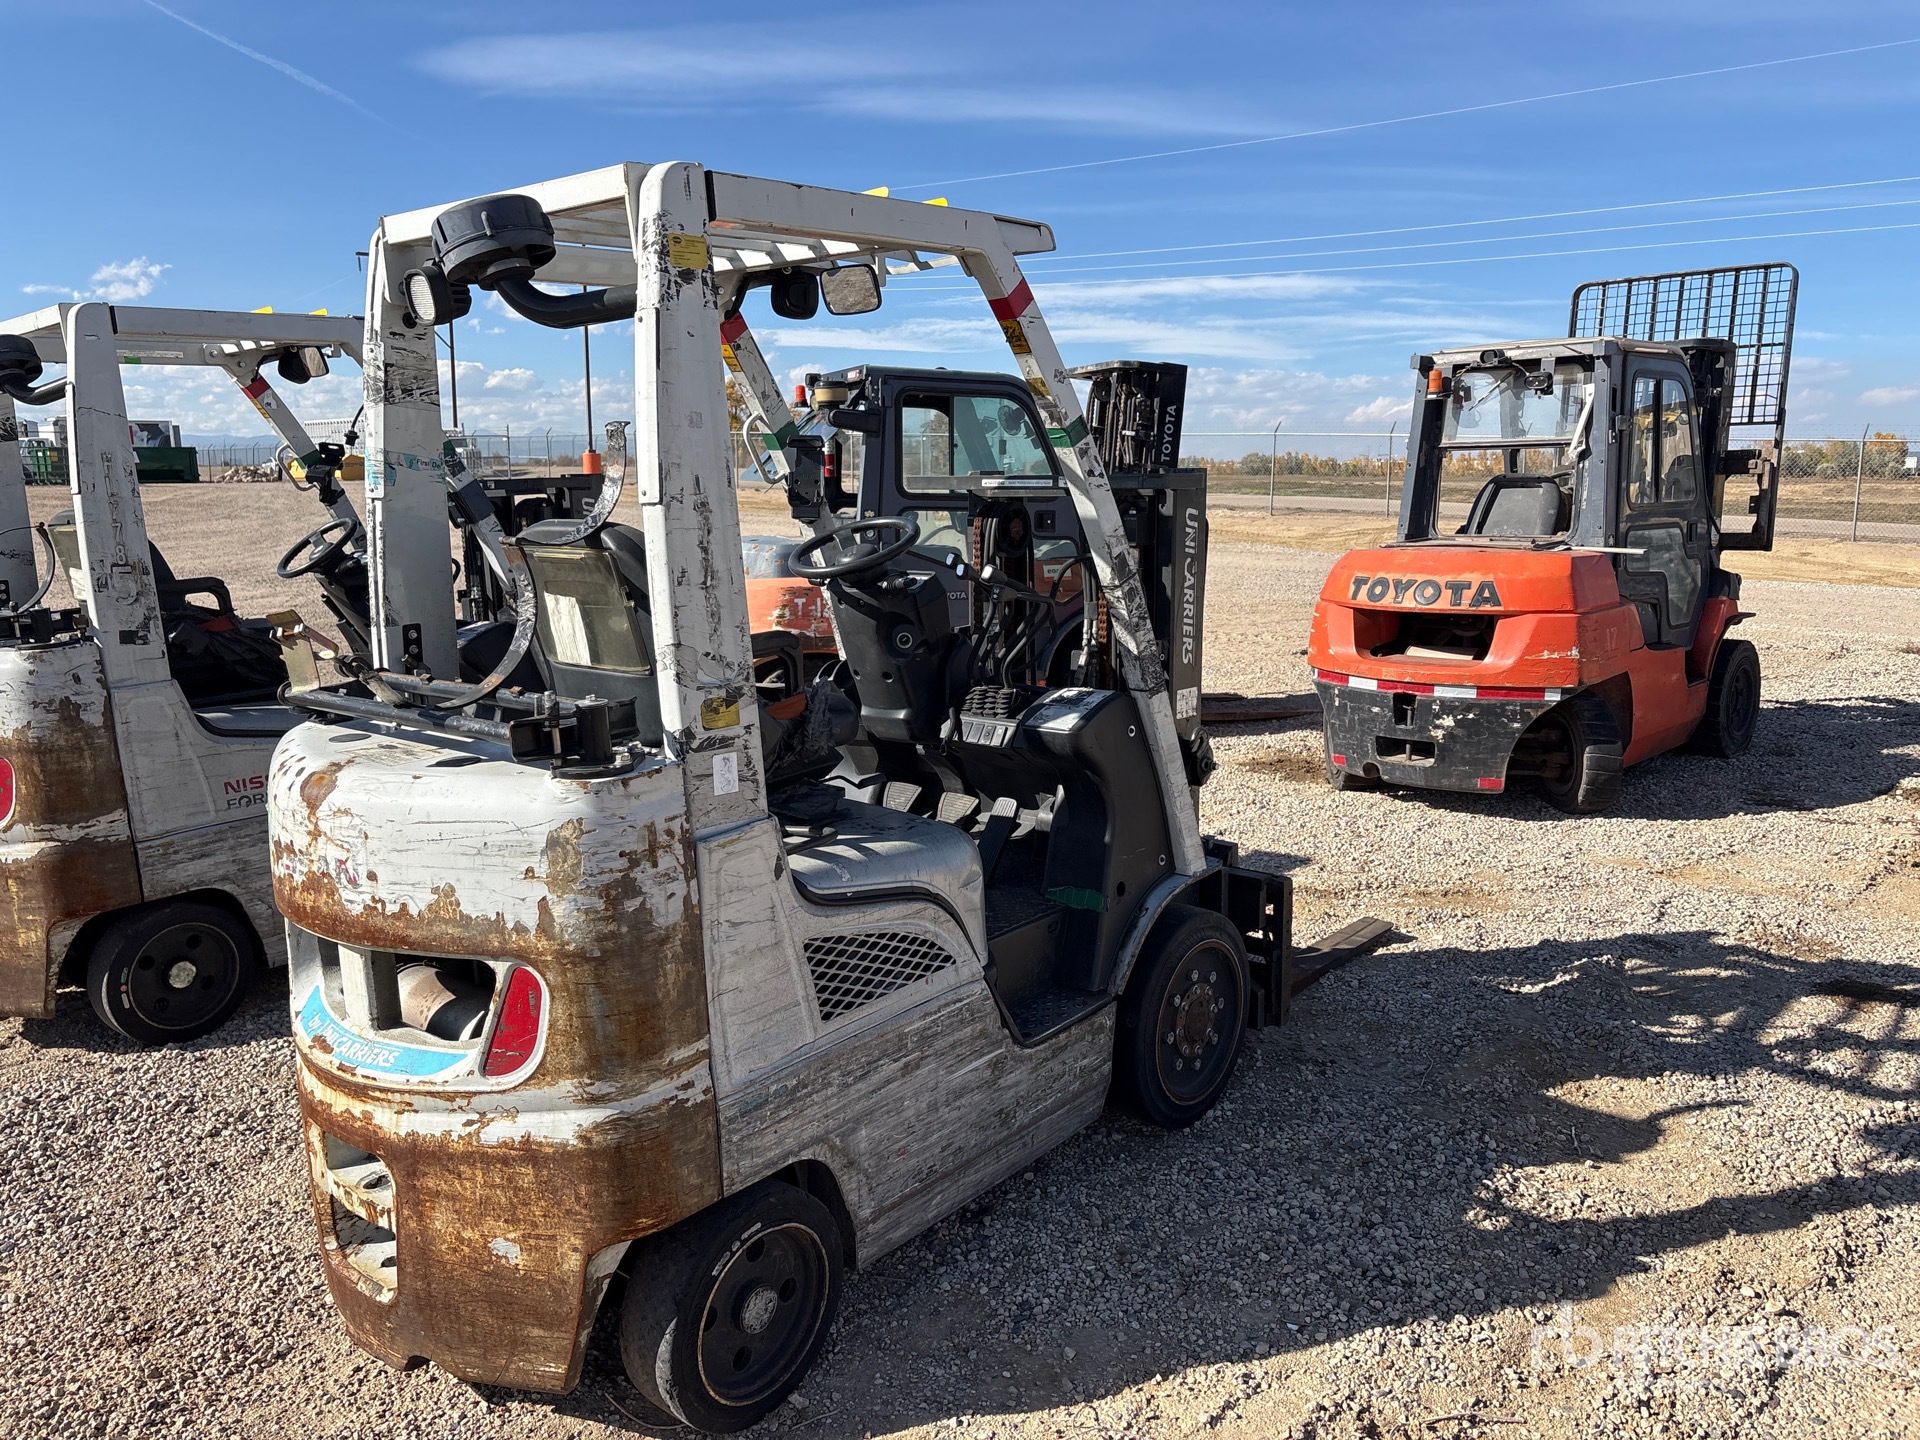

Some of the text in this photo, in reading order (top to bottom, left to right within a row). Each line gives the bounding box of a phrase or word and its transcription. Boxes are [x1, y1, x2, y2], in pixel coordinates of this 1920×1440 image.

[1160, 404, 1177, 463] TOYOTA
[1350, 576, 1503, 608] TOYOTA
[227, 792, 268, 810] FOR
[308, 1012, 403, 1067] by UNICARRIERS
